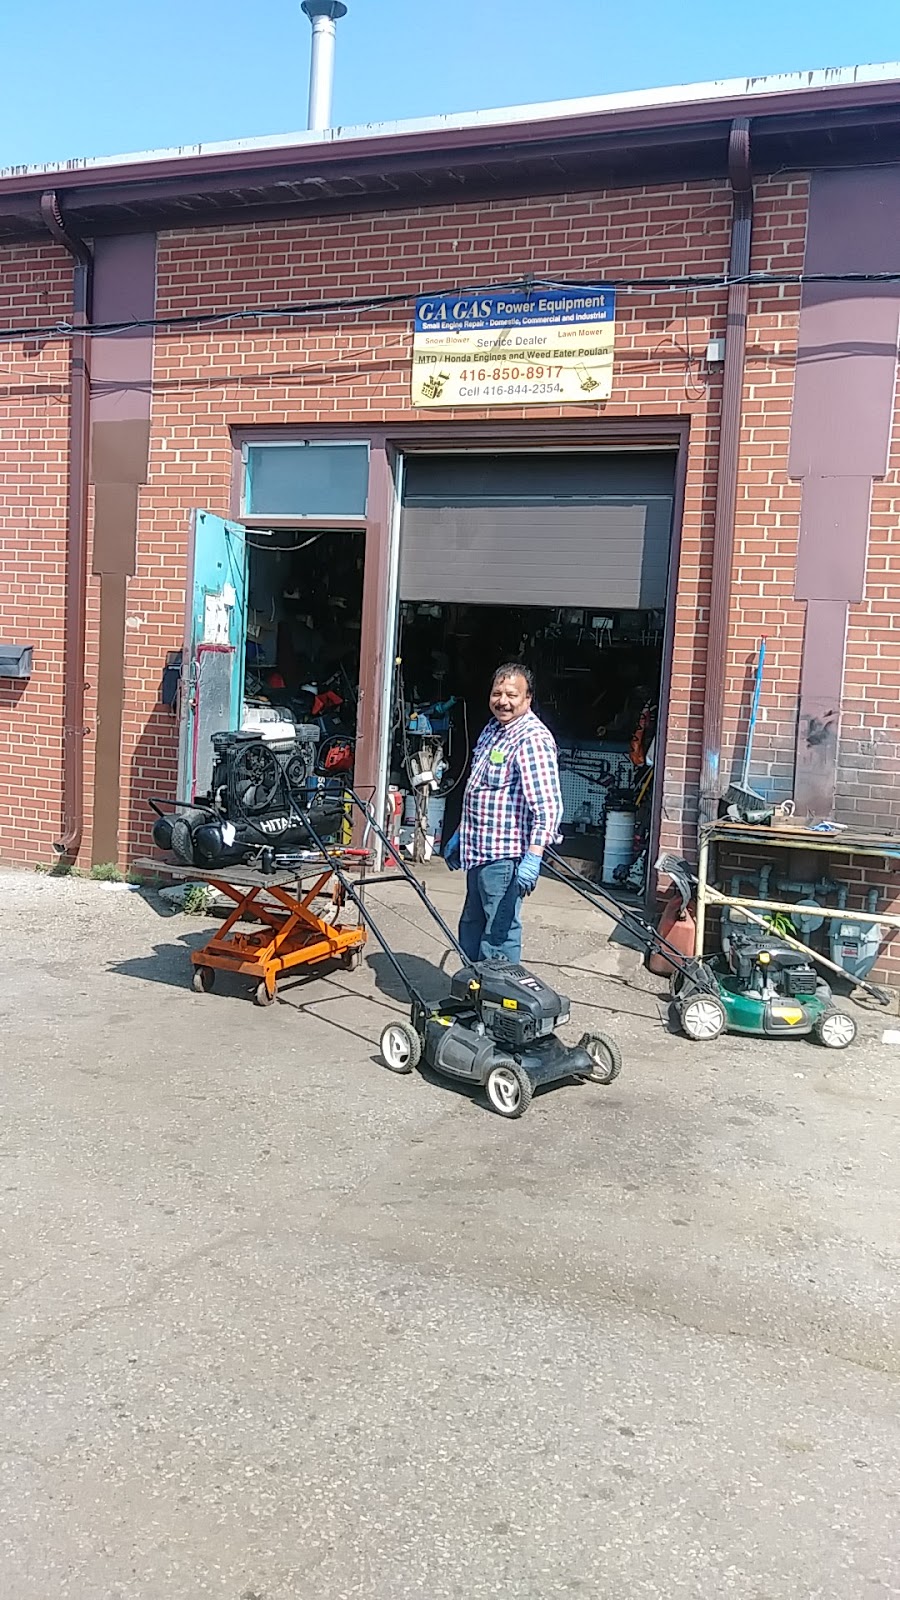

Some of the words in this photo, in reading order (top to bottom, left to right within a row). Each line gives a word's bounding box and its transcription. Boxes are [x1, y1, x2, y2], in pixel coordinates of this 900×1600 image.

[453, 300, 493, 320] GAS
[497, 302, 535, 314] Power
[538, 295, 605, 314] Equipment
[422, 321, 440, 330] Small
[441, 321, 463, 330] Engine
[464, 320, 485, 329] Repair
[490, 318, 521, 326] Domestic,
[522, 315, 560, 324] Commercial
[562, 314, 575, 322] and
[575, 311, 607, 320] Industrial
[446, 336, 470, 344] Blower
[477, 338, 512, 348] Service
[515, 335, 548, 346] Dealer
[557, 330, 577, 338] Lawn
[418, 355, 437, 364] MTD
[444, 354, 471, 363] Honda
[473, 353, 507, 363] Engines
[508, 351, 525, 360] and
[527, 350, 551, 359] Weed
[553, 349, 576, 358] Eater
[578, 347, 608, 356] Poulan
[460, 366, 563, 382] 416-850-8917
[459, 386, 480, 397] Cell
[483, 383, 560, 395] 416-844-2354
